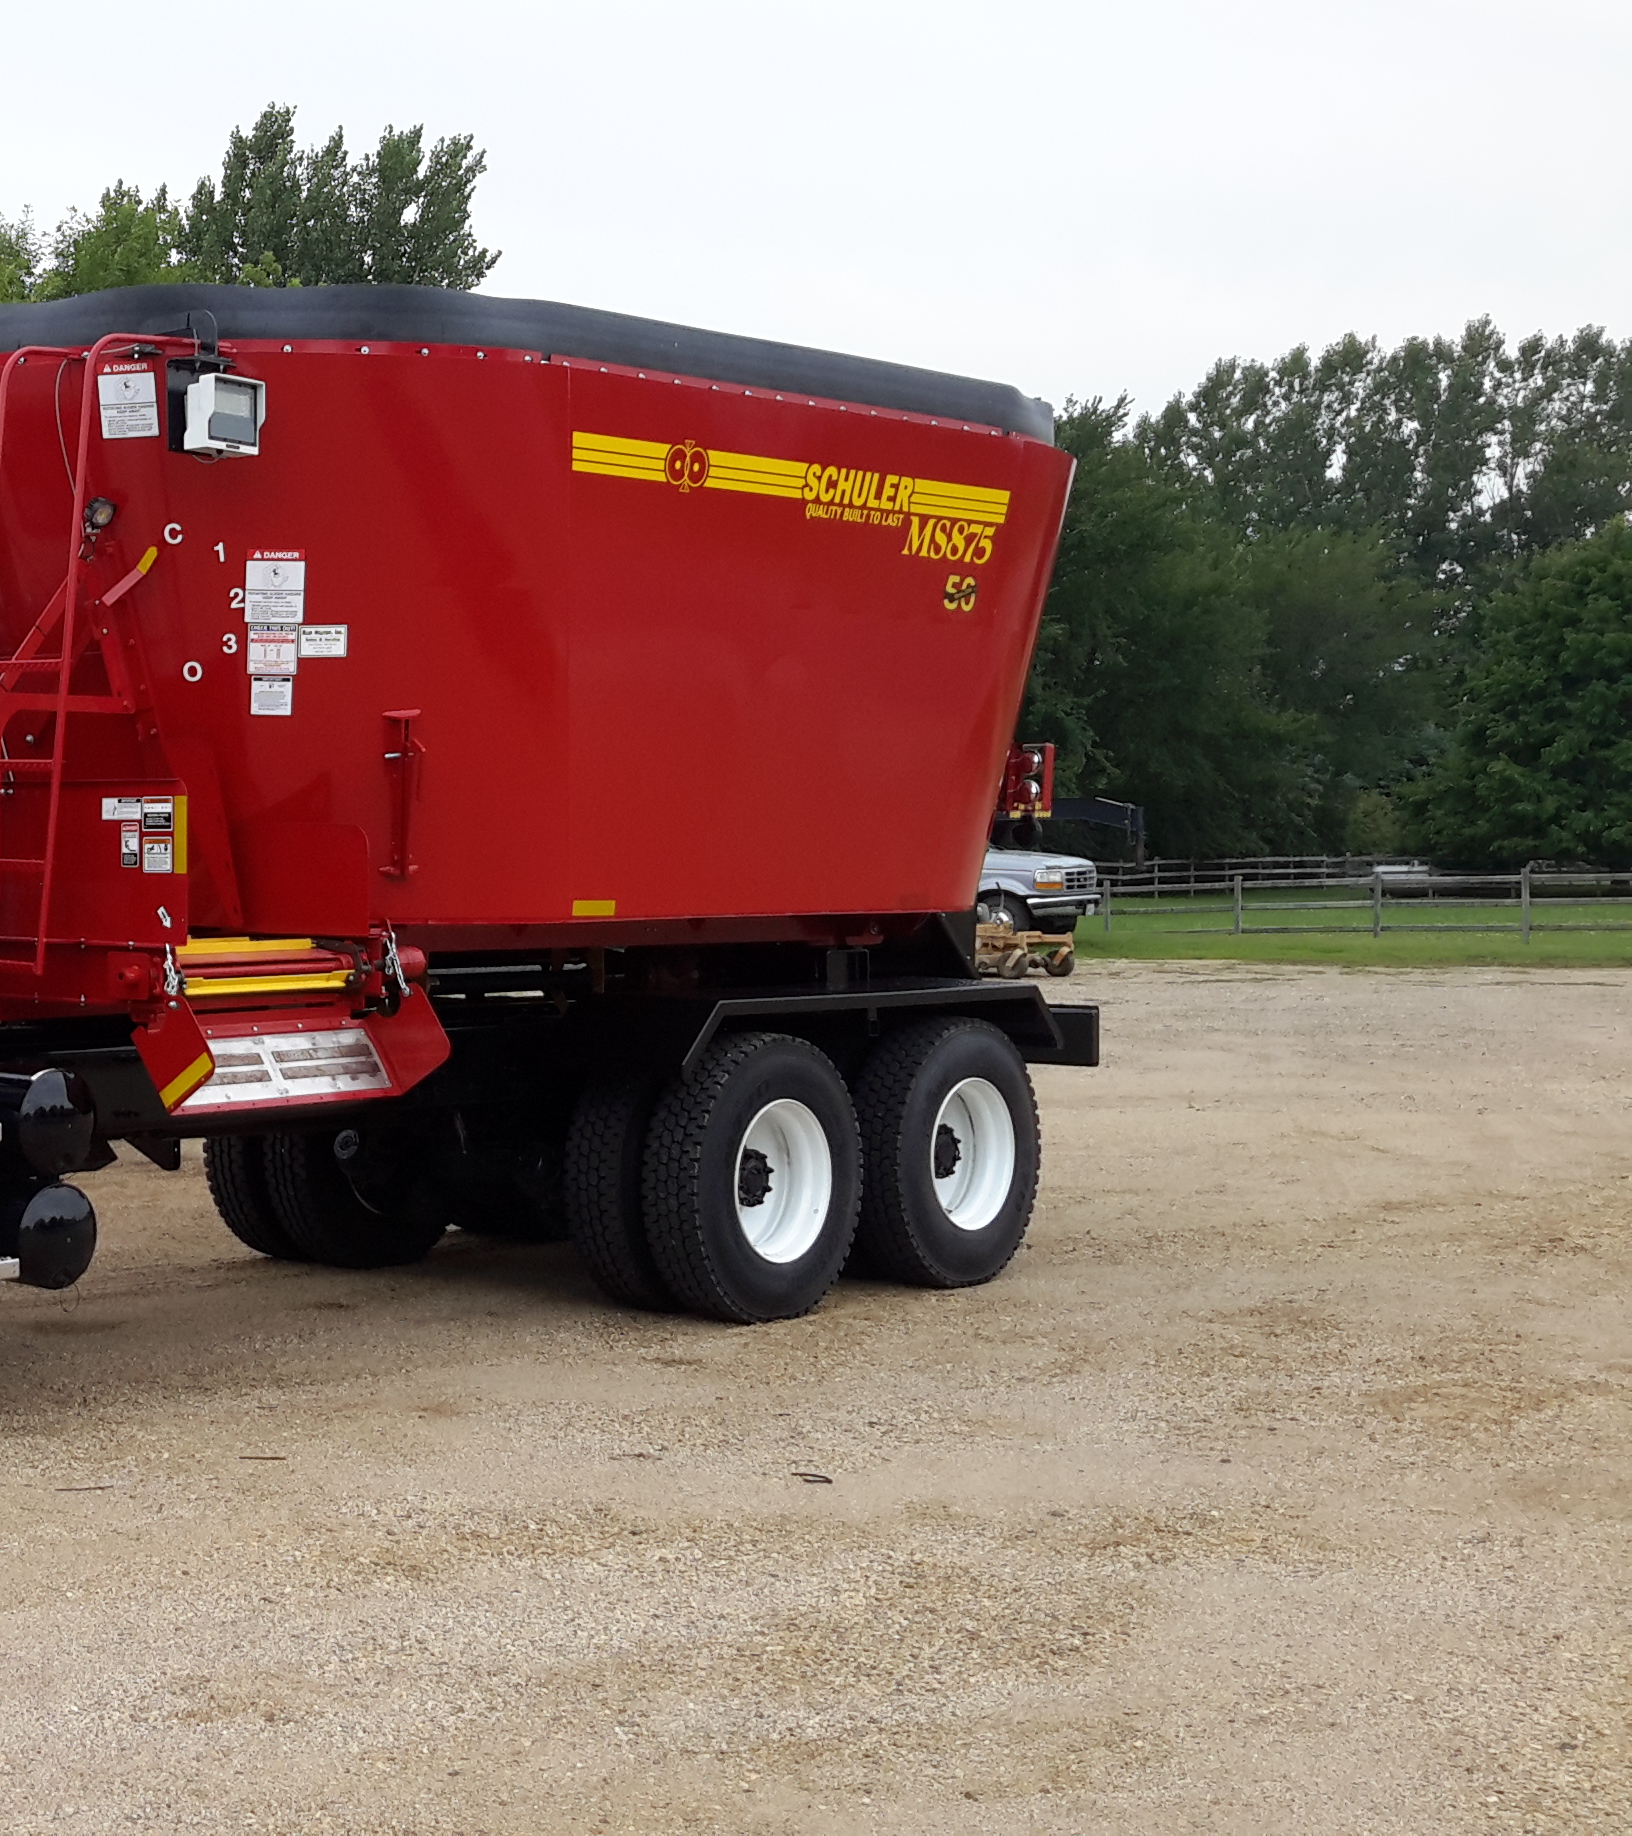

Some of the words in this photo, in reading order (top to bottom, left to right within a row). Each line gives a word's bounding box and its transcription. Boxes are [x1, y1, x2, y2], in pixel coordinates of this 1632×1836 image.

[112, 363, 148, 372] DANGER
[803, 464, 914, 512] SCHULER
[806, 503, 843, 519] QUALITY
[843, 508, 868, 523] BUILT
[869, 511, 881, 525] TO
[881, 513, 905, 527] LAST
[164, 523, 183, 545] C
[901, 516, 996, 565] MS875
[214, 542, 225, 562] 1
[263, 551, 300, 559] DANGER
[229, 588, 245, 609] 2
[222, 633, 239, 654] 3
